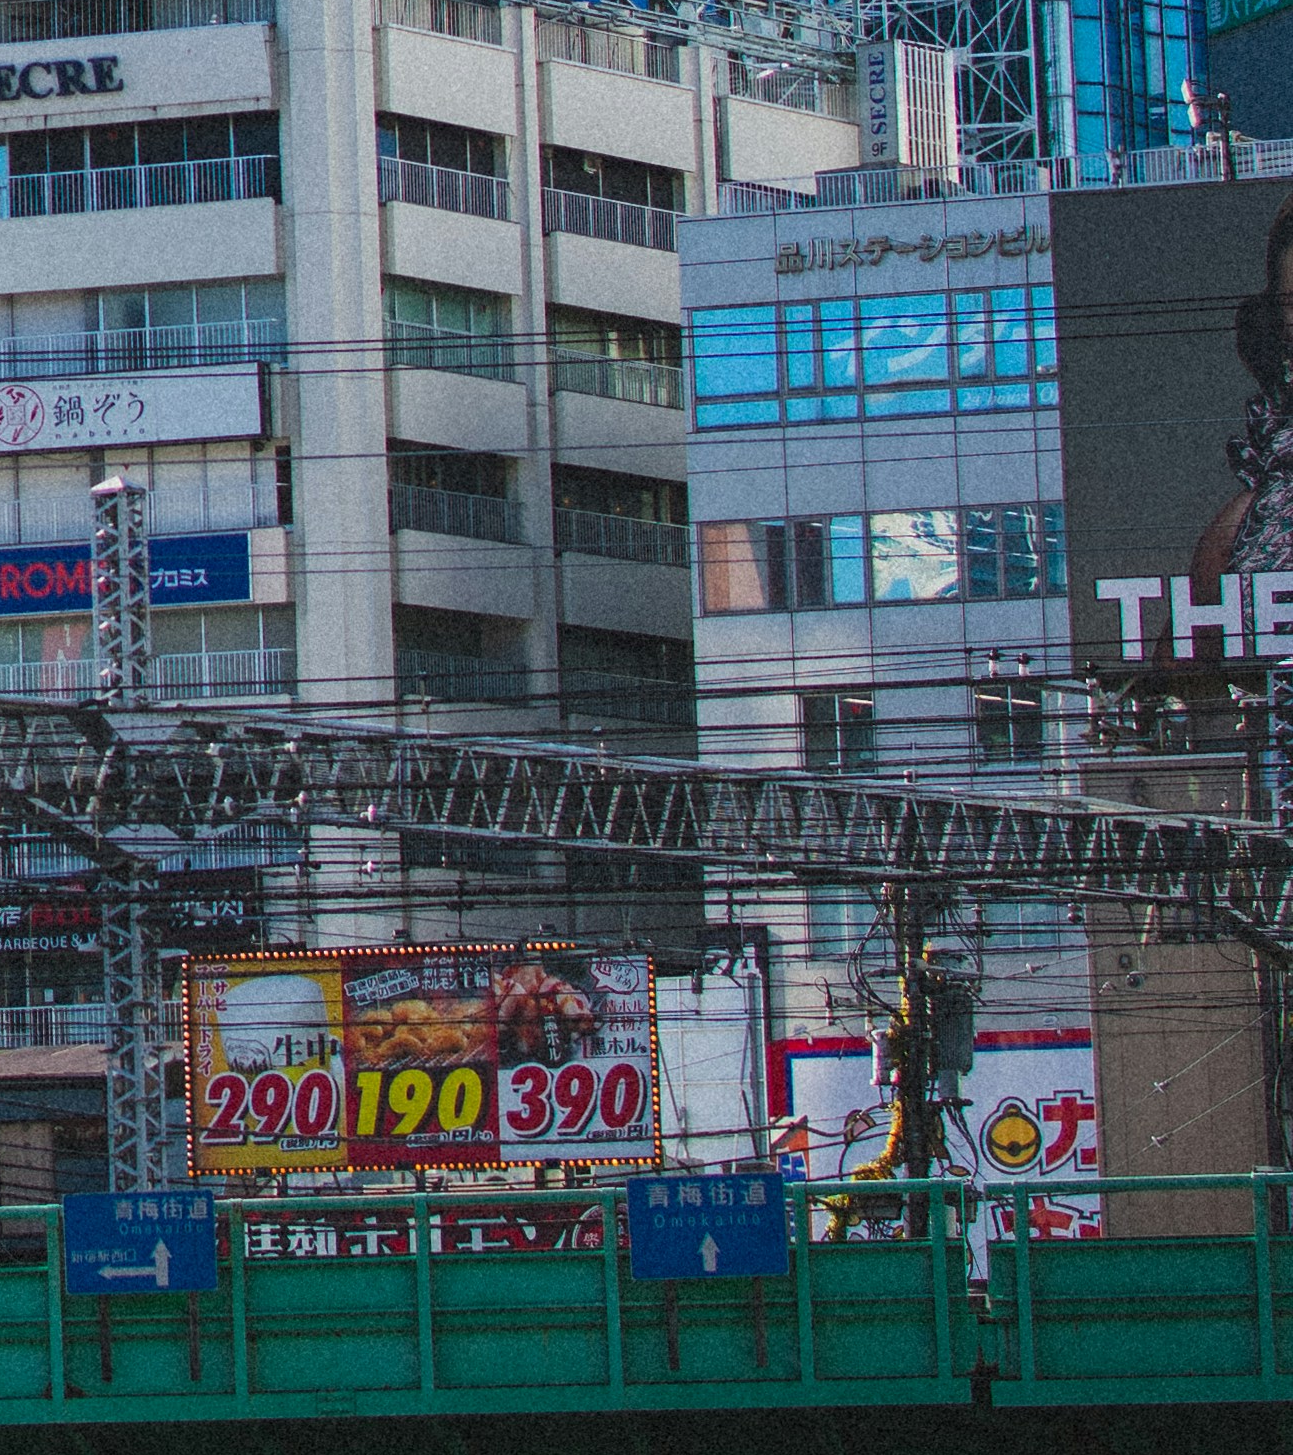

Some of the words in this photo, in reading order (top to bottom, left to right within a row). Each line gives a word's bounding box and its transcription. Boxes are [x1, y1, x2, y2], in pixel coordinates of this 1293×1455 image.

[868, 51, 888, 135] SECRE
[872, 142, 888, 157] 9F
[774, 223, 1051, 274] 品川ステーションビル
[53, 391, 146, 428] 鍋ぞう
[150, 568, 209, 589] プロミス
[272, 1032, 340, 1068] 生中
[200, 1070, 340, 1143] 290
[356, 1067, 483, 1136] 190
[506, 1062, 647, 1137] 390
[115, 1195, 209, 1221] 青梅街道
[645, 1179, 767, 1209] 青梅街道
